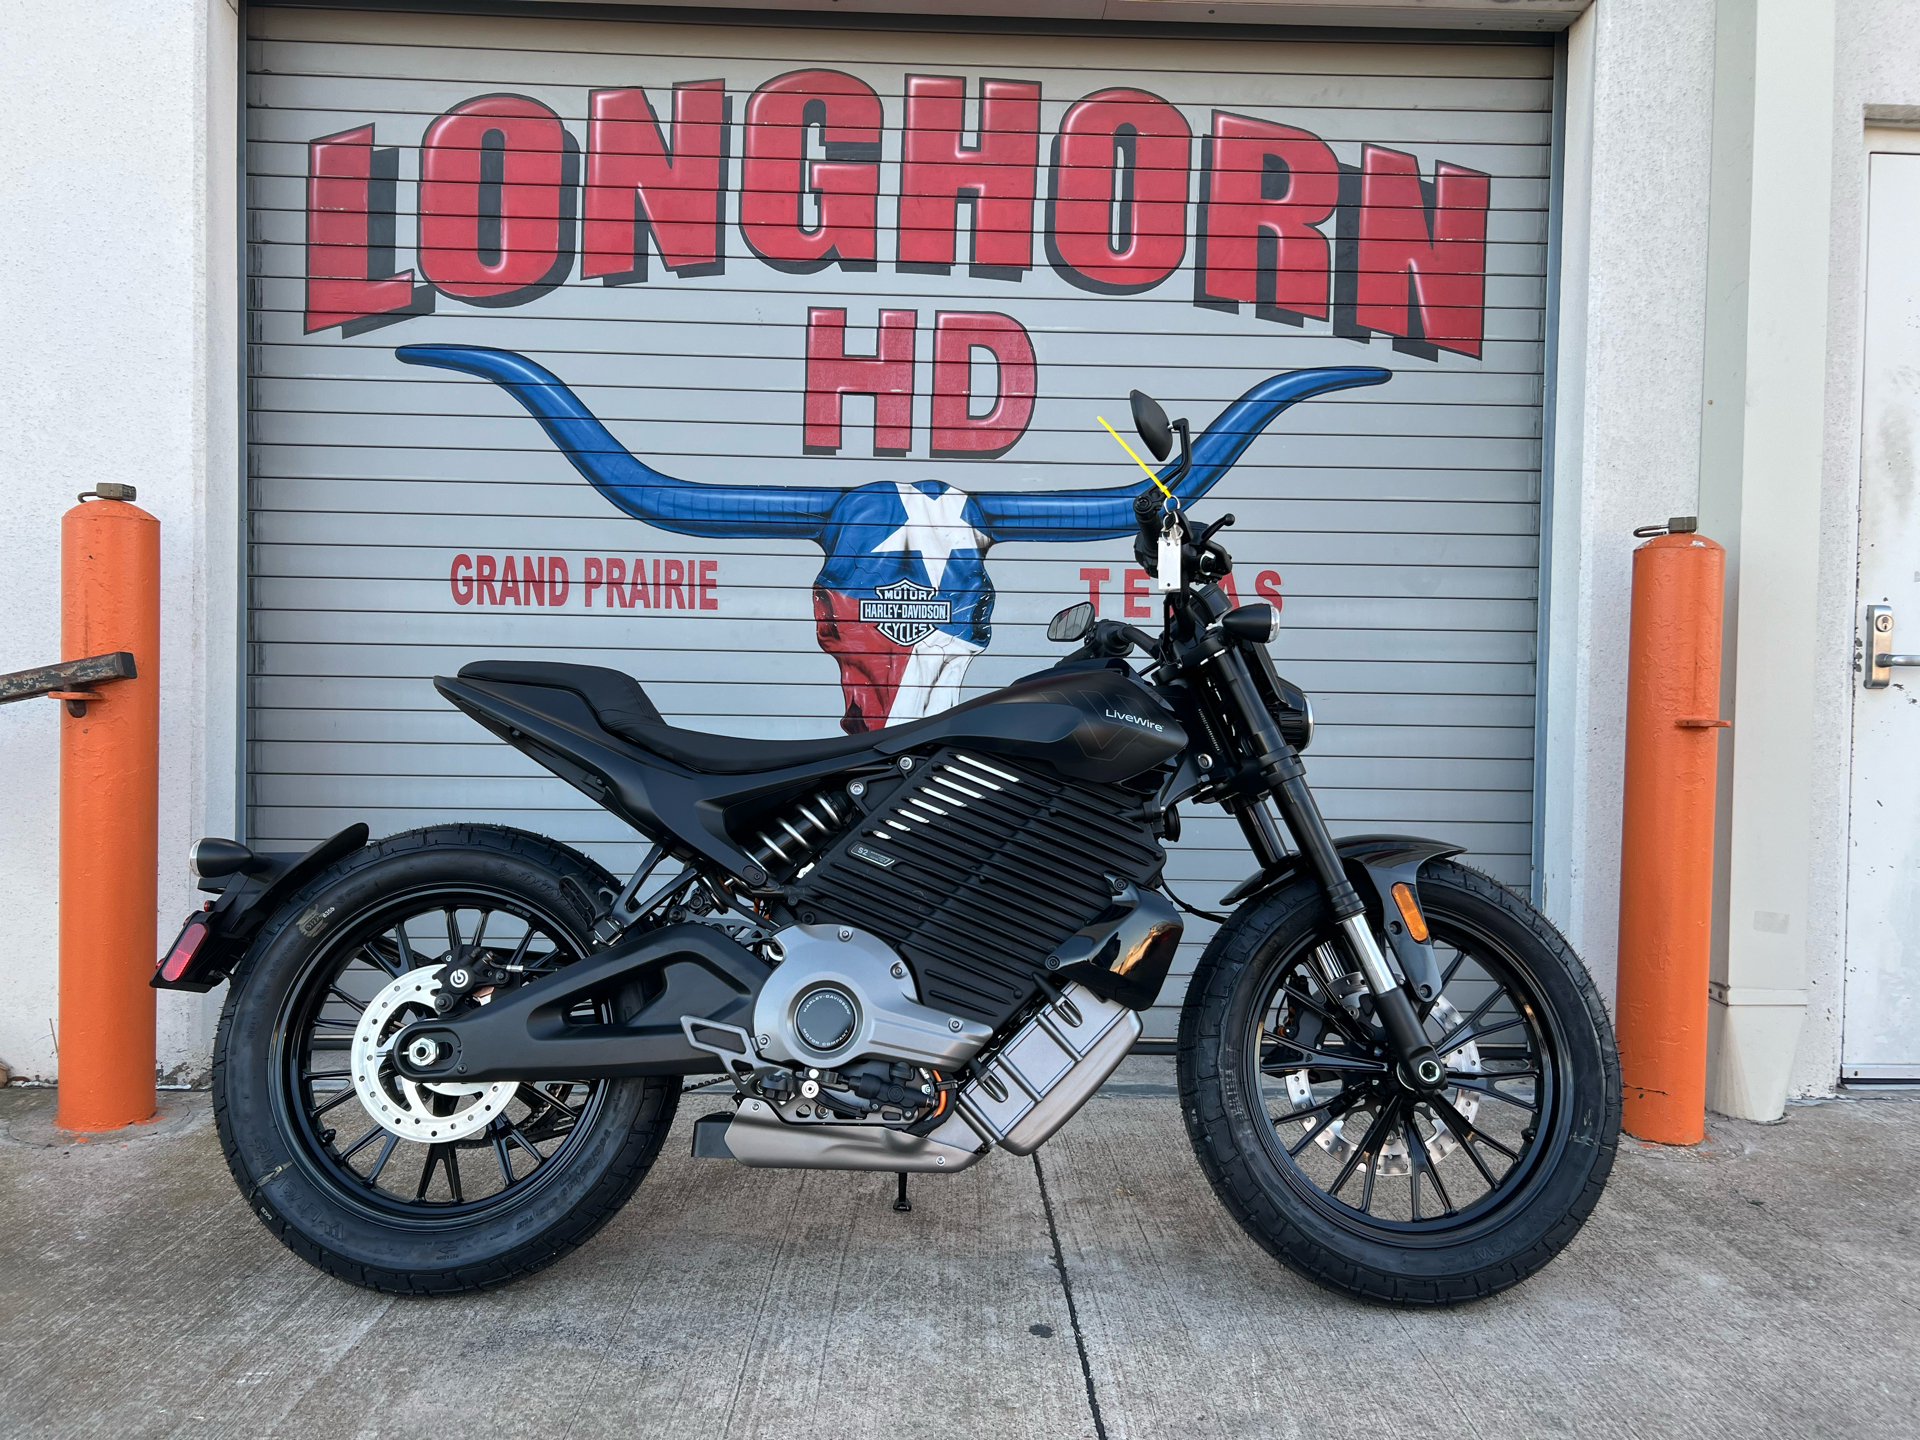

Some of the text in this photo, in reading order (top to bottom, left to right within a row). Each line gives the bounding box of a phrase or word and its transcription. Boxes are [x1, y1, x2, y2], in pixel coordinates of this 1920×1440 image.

[304, 68, 1491, 361] LONGHORN
[803, 307, 1038, 459] HD
[450, 553, 719, 611] GRAND PRAIRIE
[885, 583, 927, 600] MOTOR
[1080, 567, 1283, 619] TEAS
[864, 603, 947, 619] HARLEY-DAVIDSON
[884, 623, 927, 643] CYCLES
[1105, 708, 1163, 733] LiveWire
[857, 846, 869, 857] S2
[803, 994, 851, 1016] HARLEY-DAVIDSON
[802, 1027, 849, 1047] MOTOR COMPANY
